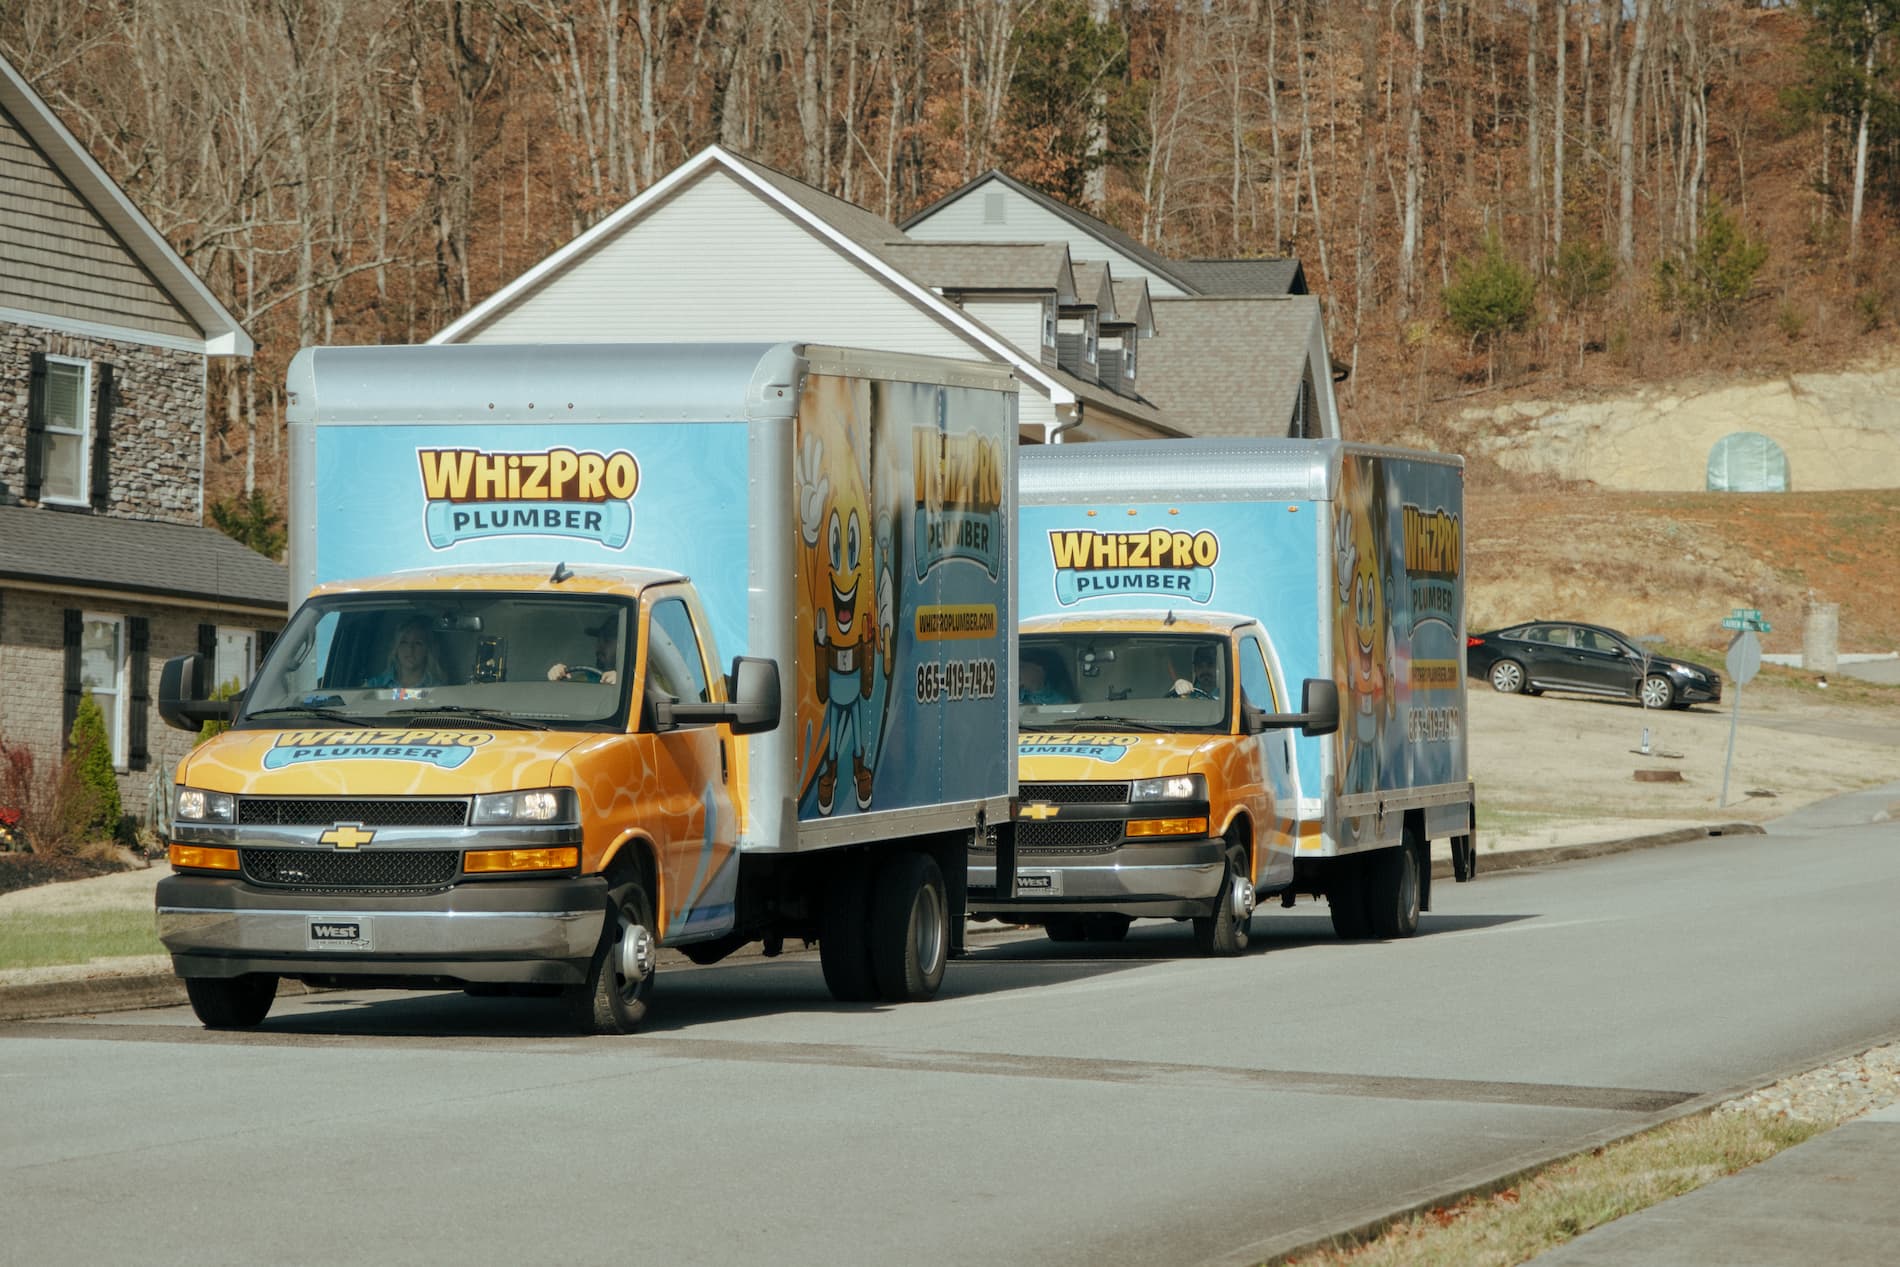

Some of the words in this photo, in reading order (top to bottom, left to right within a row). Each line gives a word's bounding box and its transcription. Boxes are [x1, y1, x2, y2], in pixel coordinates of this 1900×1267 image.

[453, 508, 602, 531] PLUMBER
[928, 519, 989, 553] PLUMBER
[1076, 574, 1191, 592] PLUMBER
[1413, 587, 1453, 617] PLUMBER
[920, 613, 994, 632] WHIZPROPLUMBER.COM
[917, 662, 996, 699] 865-419-7429
[1018, 735, 1138, 746] HIZPRO
[293, 748, 443, 759] PLUMBER
[1019, 747, 1105, 755] UMBER
